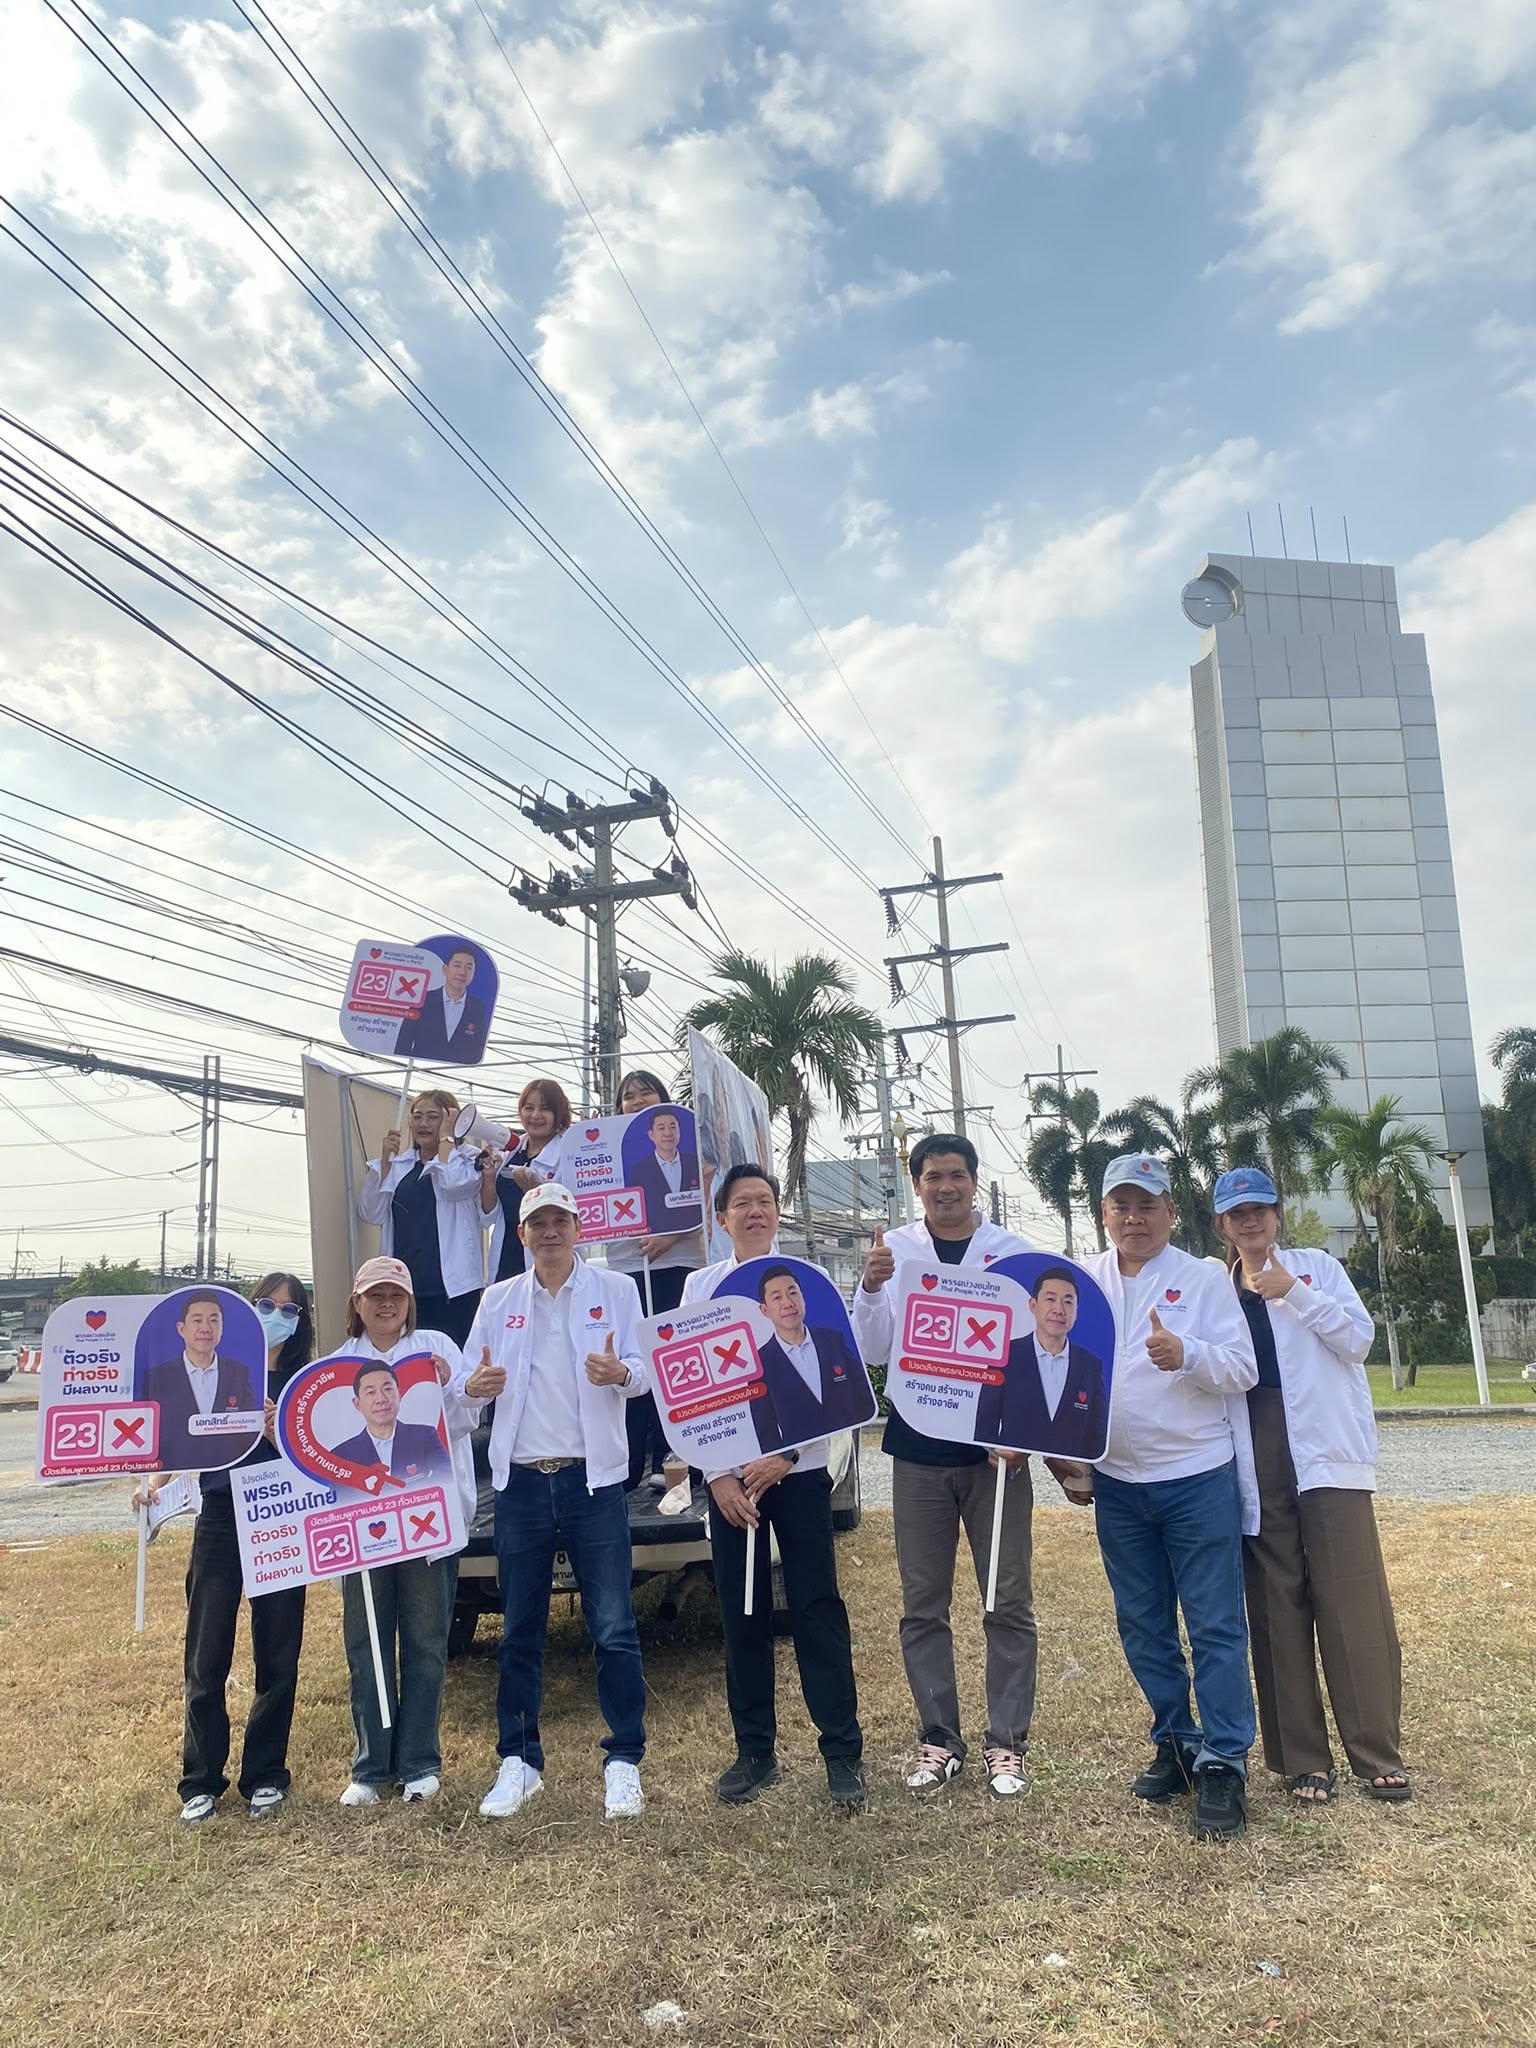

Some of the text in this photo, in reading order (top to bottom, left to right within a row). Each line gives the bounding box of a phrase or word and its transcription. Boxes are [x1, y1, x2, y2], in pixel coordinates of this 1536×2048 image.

[361, 973, 388, 991] 23
[575, 1154, 612, 1168] ตัวจริง
[576, 1166, 612, 1179] ทำจริง
[577, 1177, 613, 1189] มีผลงาน
[579, 1205, 604, 1224] 23
[941, 1277, 1000, 1292] พรรคปวงชนไทย
[981, 1291, 997, 1299] Party
[505, 1315, 525, 1329] 23
[675, 1305, 731, 1329] พรรคปวงชนไทย
[915, 1313, 951, 1341] 23
[63, 1349, 120, 1364] ตัวจริง
[63, 1366, 119, 1381] ทำจริง
[668, 1356, 705, 1387] 23
[63, 1384, 118, 1395] มีผลงาน
[905, 1379, 974, 1398] สร้างคน สร้างงาน
[917, 1395, 960, 1409] สร้างอาชีพ
[681, 1410, 746, 1438] สร้างคน สร้างงาน
[57, 1422, 97, 1449] 23
[697, 1426, 737, 1446] สร้างอาชีพ
[316, 1456, 352, 1478] สร้างคน
[242, 1470, 279, 1485] โปรดเลือก
[243, 1481, 292, 1503] พรรค
[247, 1490, 337, 1522] ปวงชนไทย
[385, 1500, 397, 1509] 23
[251, 1524, 298, 1544] ตัวจริง
[254, 1546, 300, 1566] ทำจริง
[316, 1534, 351, 1562] 23
[256, 1565, 304, 1583] มีผลงาน
